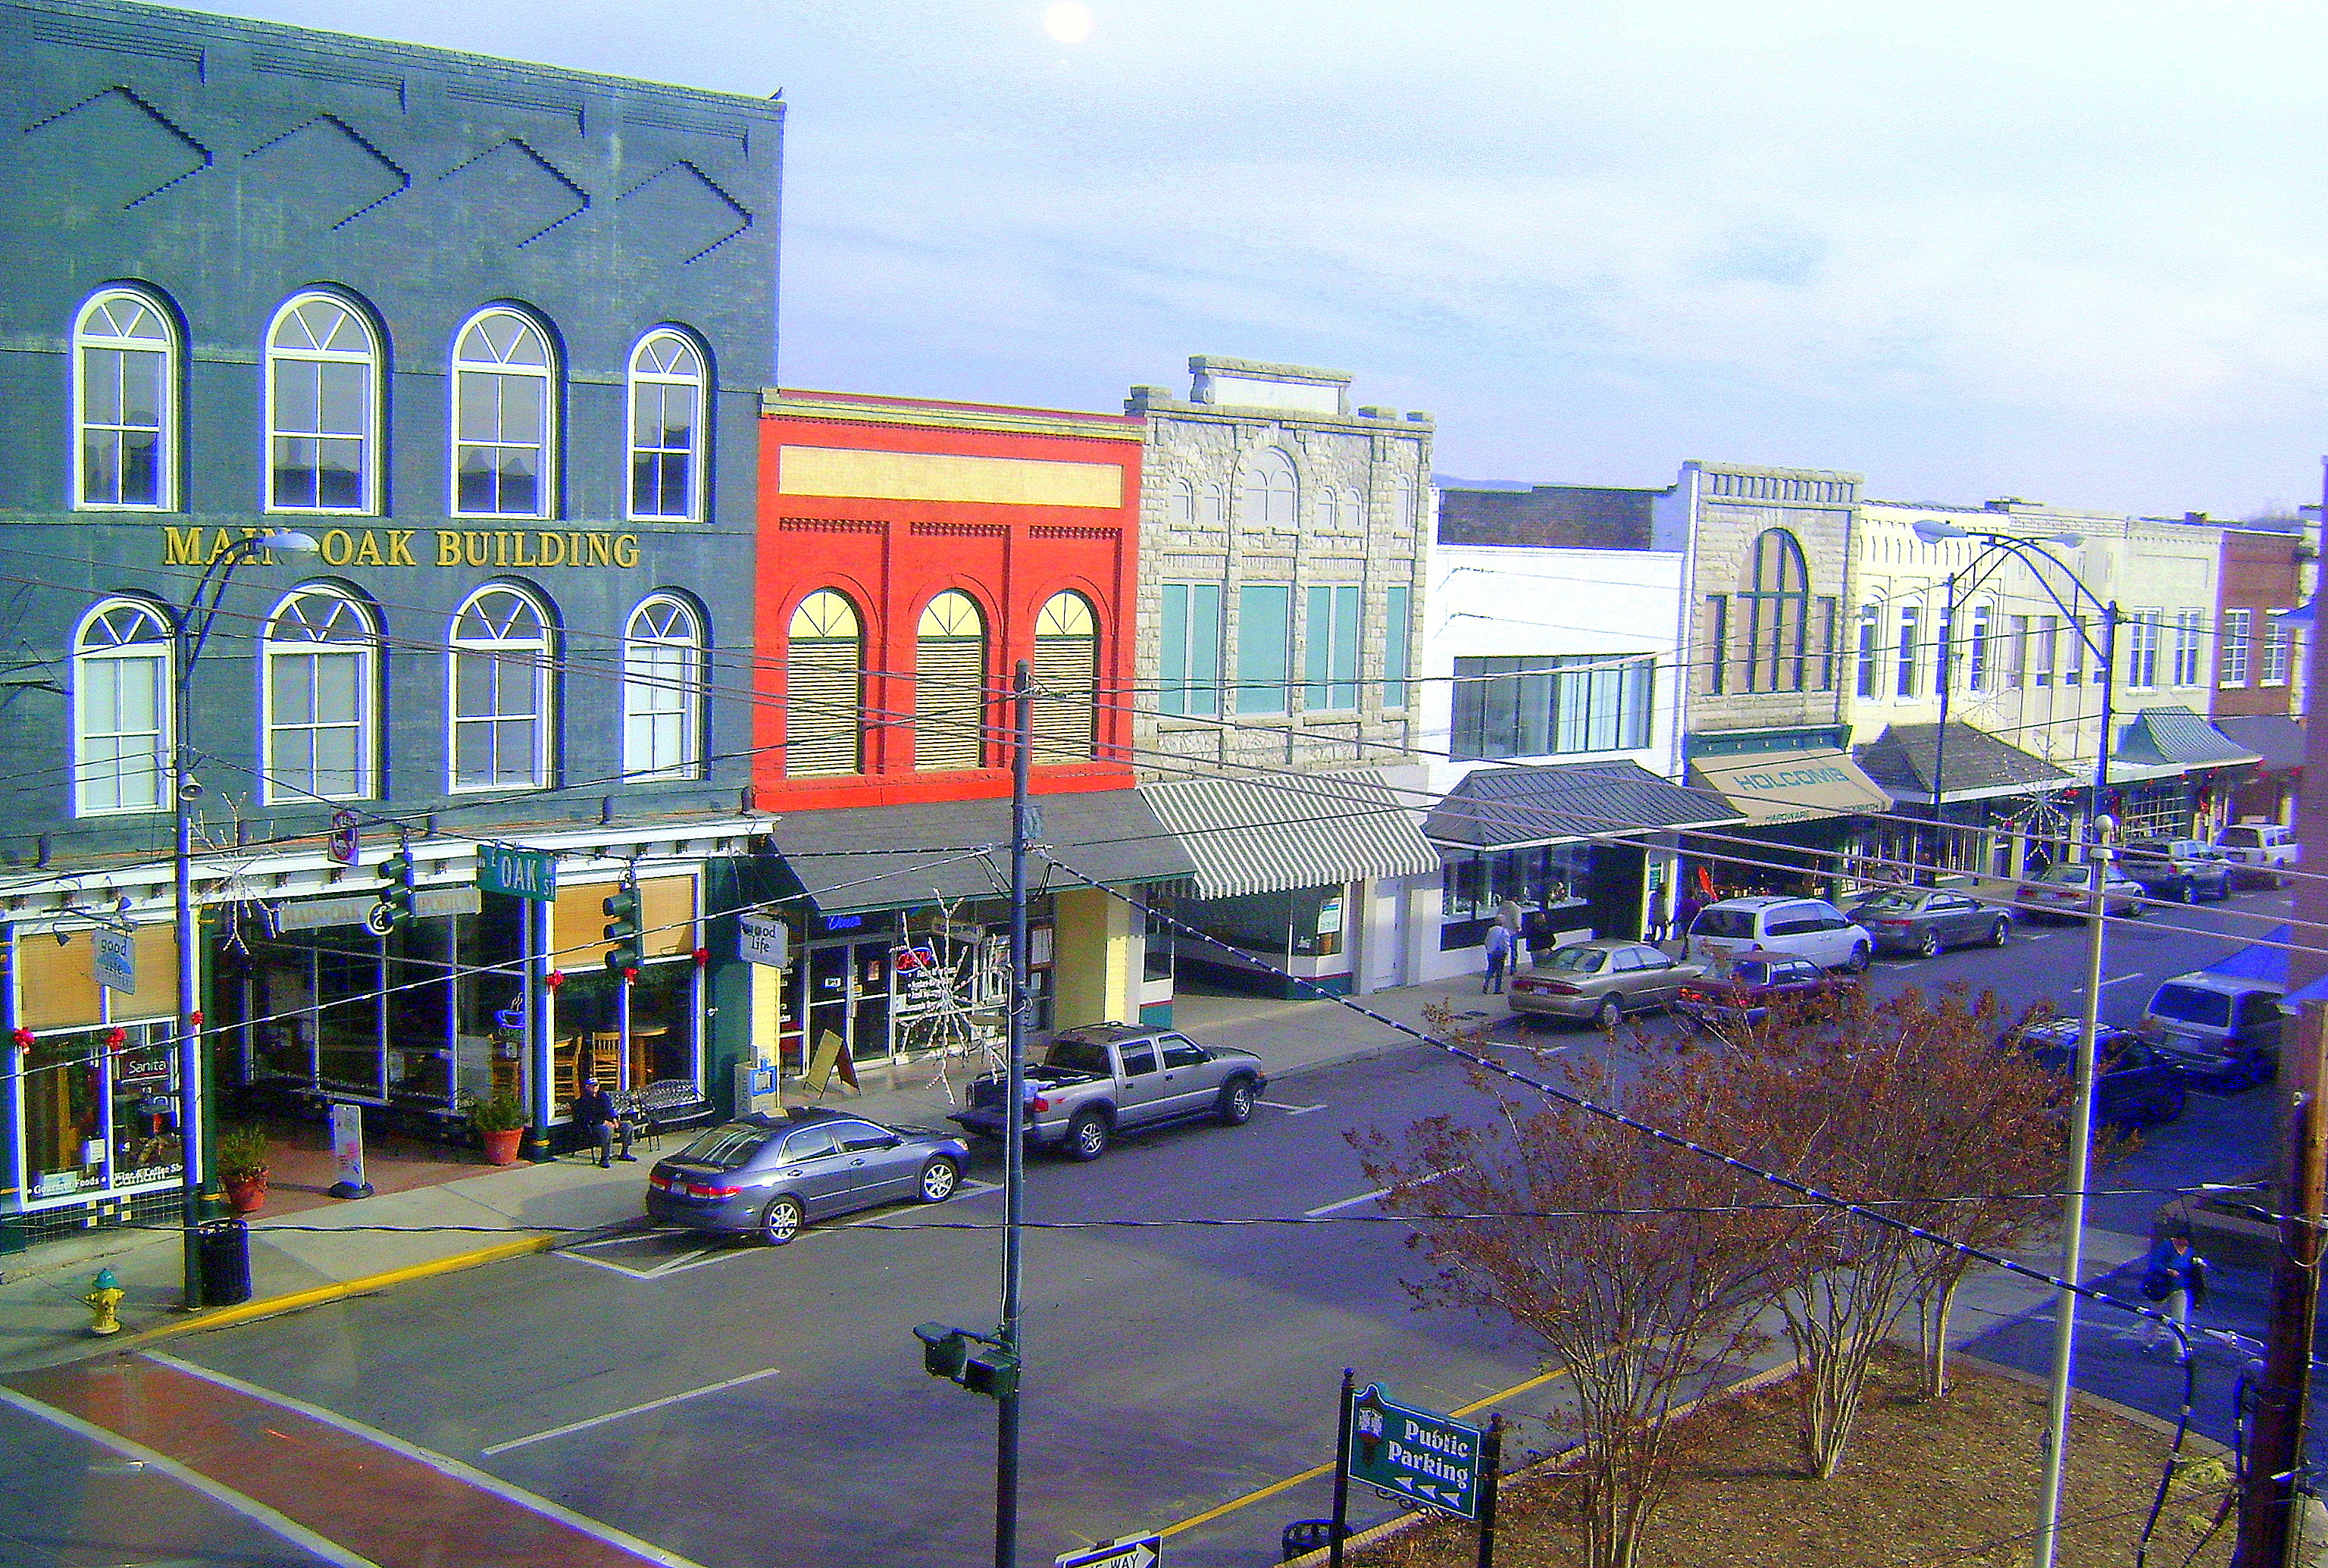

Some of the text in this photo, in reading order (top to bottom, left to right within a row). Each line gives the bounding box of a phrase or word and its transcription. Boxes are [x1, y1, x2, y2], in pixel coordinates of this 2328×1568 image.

[321, 530, 417, 567] OAK
[436, 531, 641, 568] BUILDING
[1733, 767, 1850, 791] HOLCOMB
[502, 856, 537, 892] OAK
[101, 939, 127, 956] good
[129, 1059, 167, 1075] Sanita
[74, 1175, 99, 1188] Foods
[1404, 1419, 1469, 1458] Public
[1388, 1440, 1469, 1489] Parking
[1110, 1554, 1140, 1568] WAY
